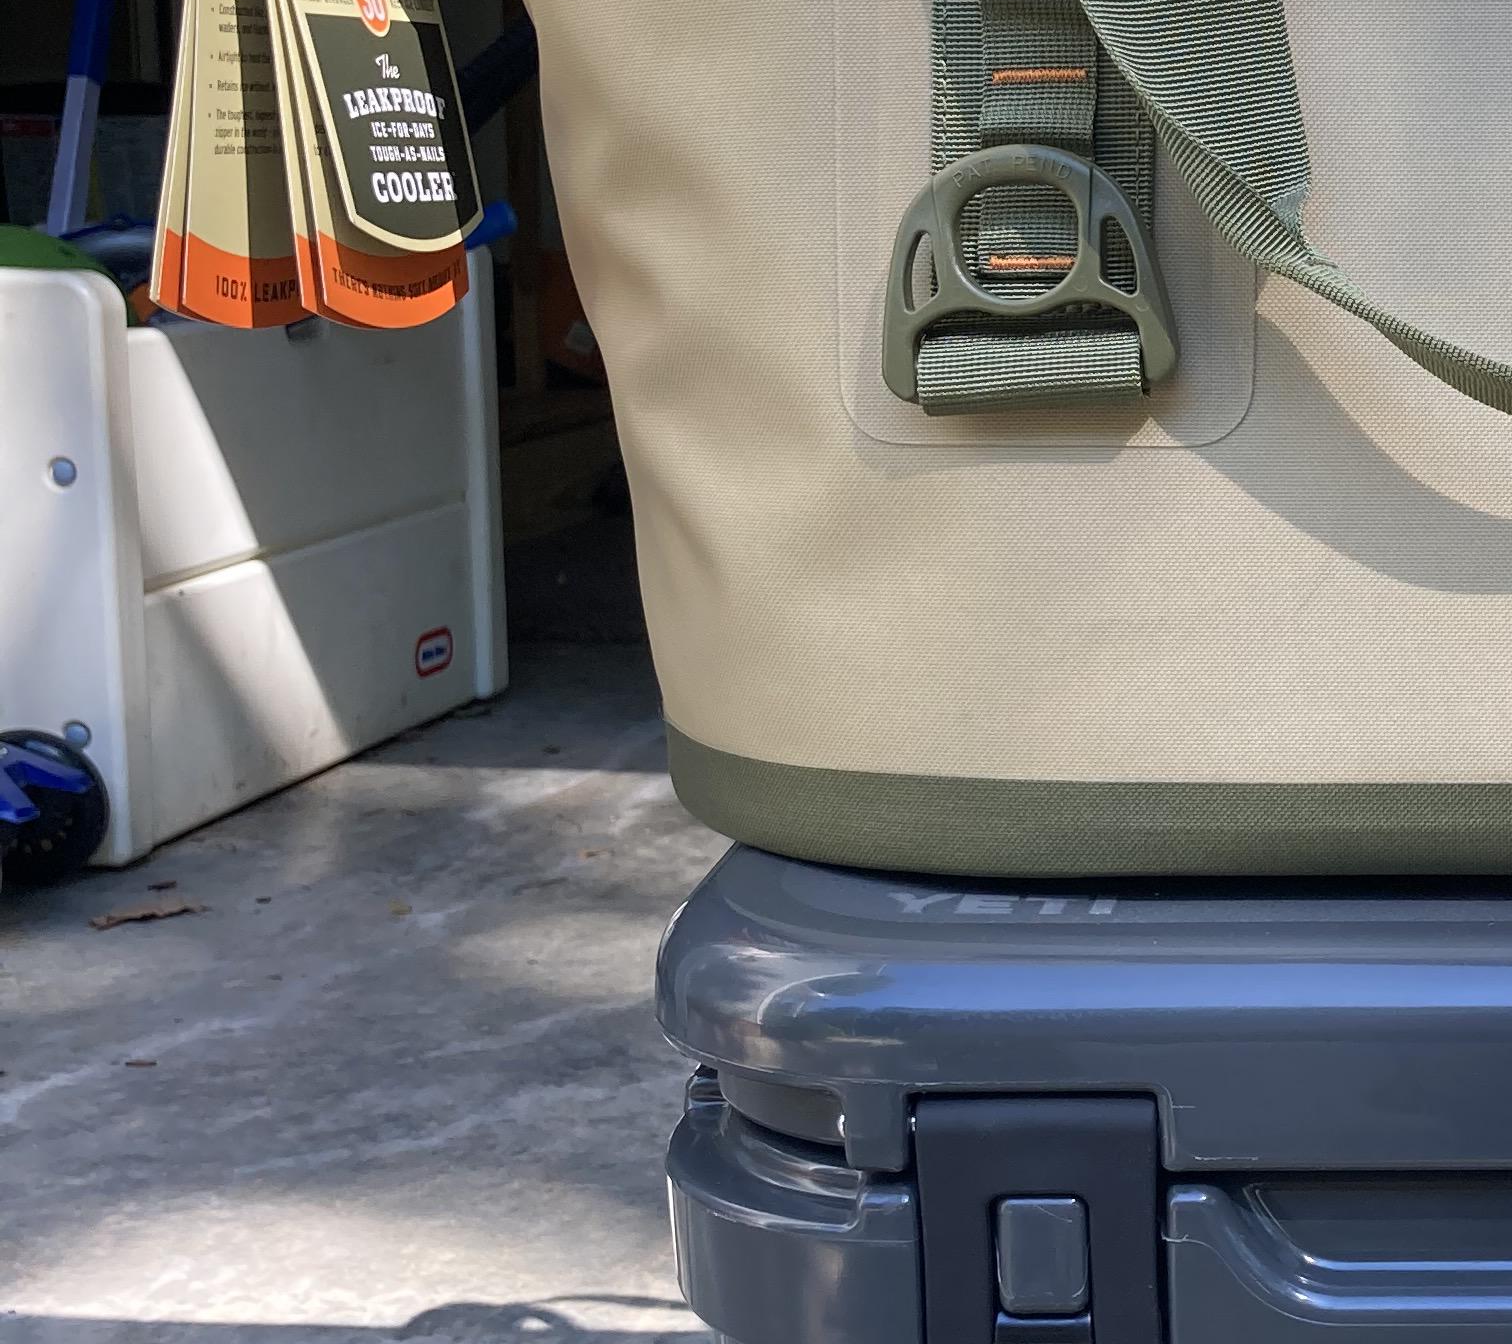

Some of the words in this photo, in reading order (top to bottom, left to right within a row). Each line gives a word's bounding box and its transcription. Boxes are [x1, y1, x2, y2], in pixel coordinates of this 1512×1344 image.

[375, 53, 400, 79] The
[343, 87, 446, 120] LEAKPROOF
[370, 121, 436, 139] ICE-FOR-DAYS
[369, 145, 446, 163] TOUGH-AS-NAILS
[371, 171, 458, 203] COOLER
[215, 274, 248, 303] 100%
[254, 278, 300, 303] LEAKP
[887, 892, 1118, 915] YETI
